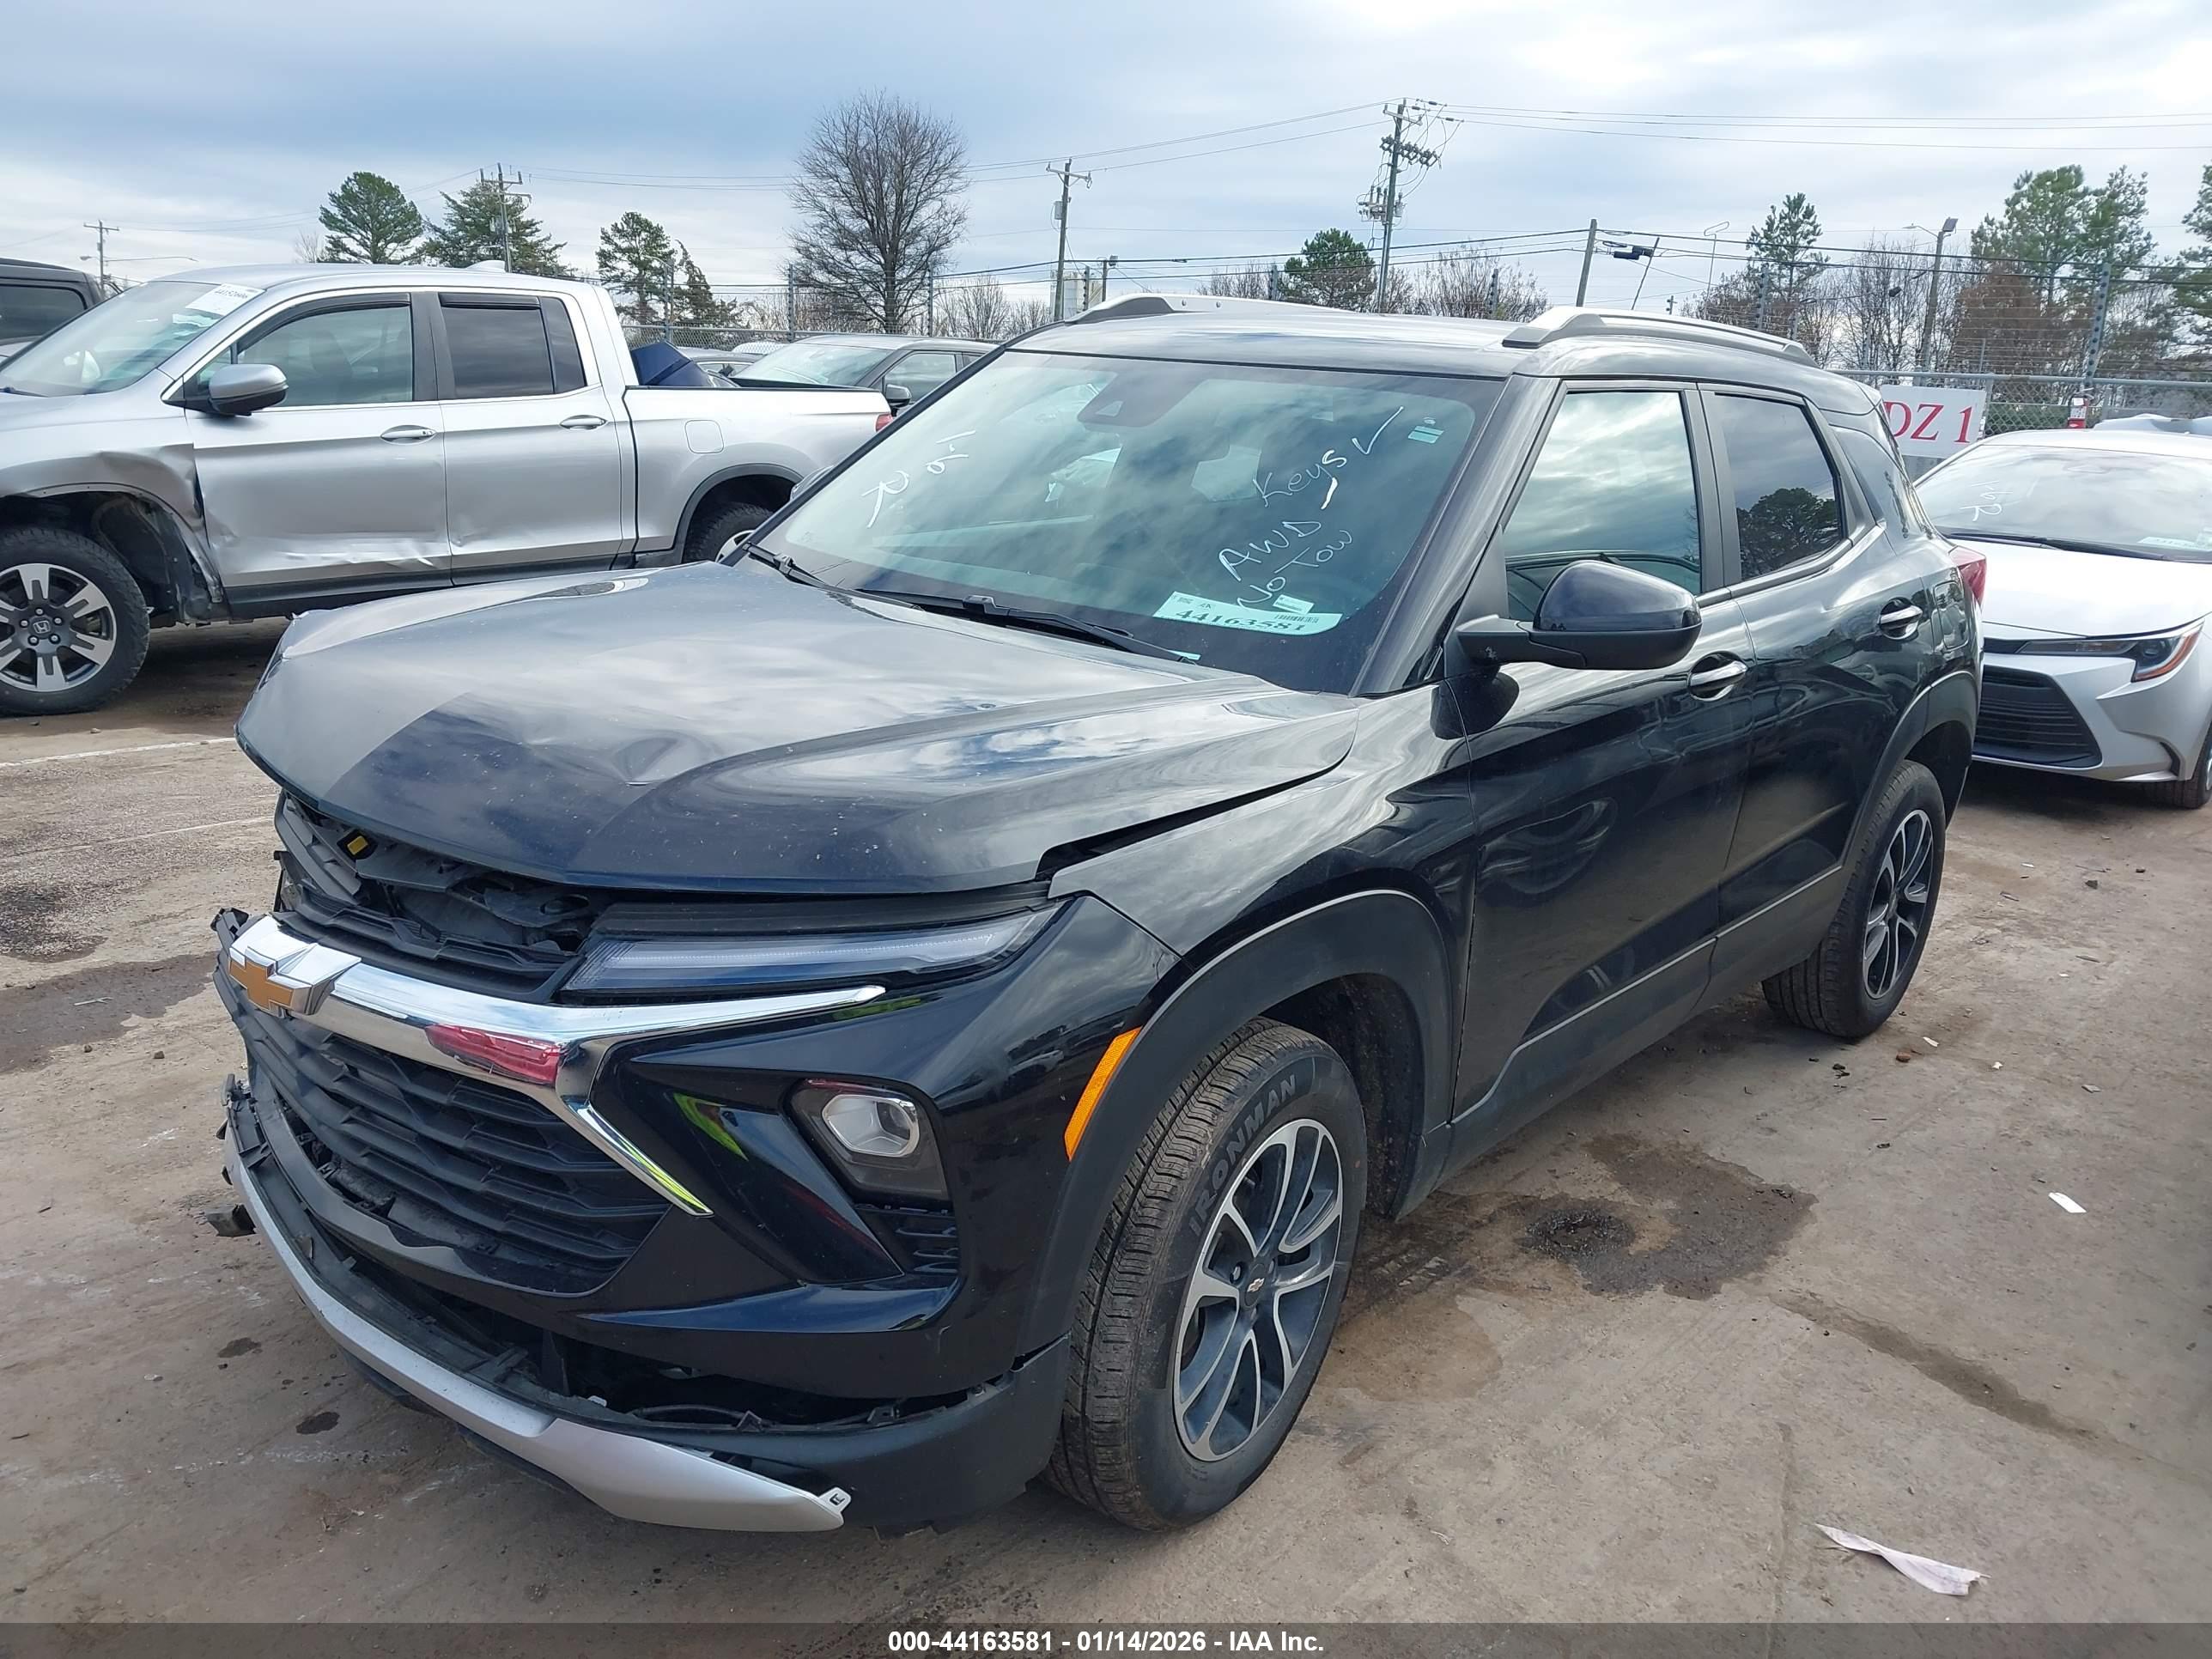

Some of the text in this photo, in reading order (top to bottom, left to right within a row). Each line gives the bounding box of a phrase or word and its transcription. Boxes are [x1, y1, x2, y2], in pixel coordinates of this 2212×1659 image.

[1883, 401, 1973, 444] DZ 1
[1252, 449, 1347, 509] Keys
[1219, 520, 1322, 581] AWD
[1237, 529, 1352, 609] No Tow
[1176, 610, 1307, 633] 44163581
[1187, 1073, 1297, 1236] IRONMAN
